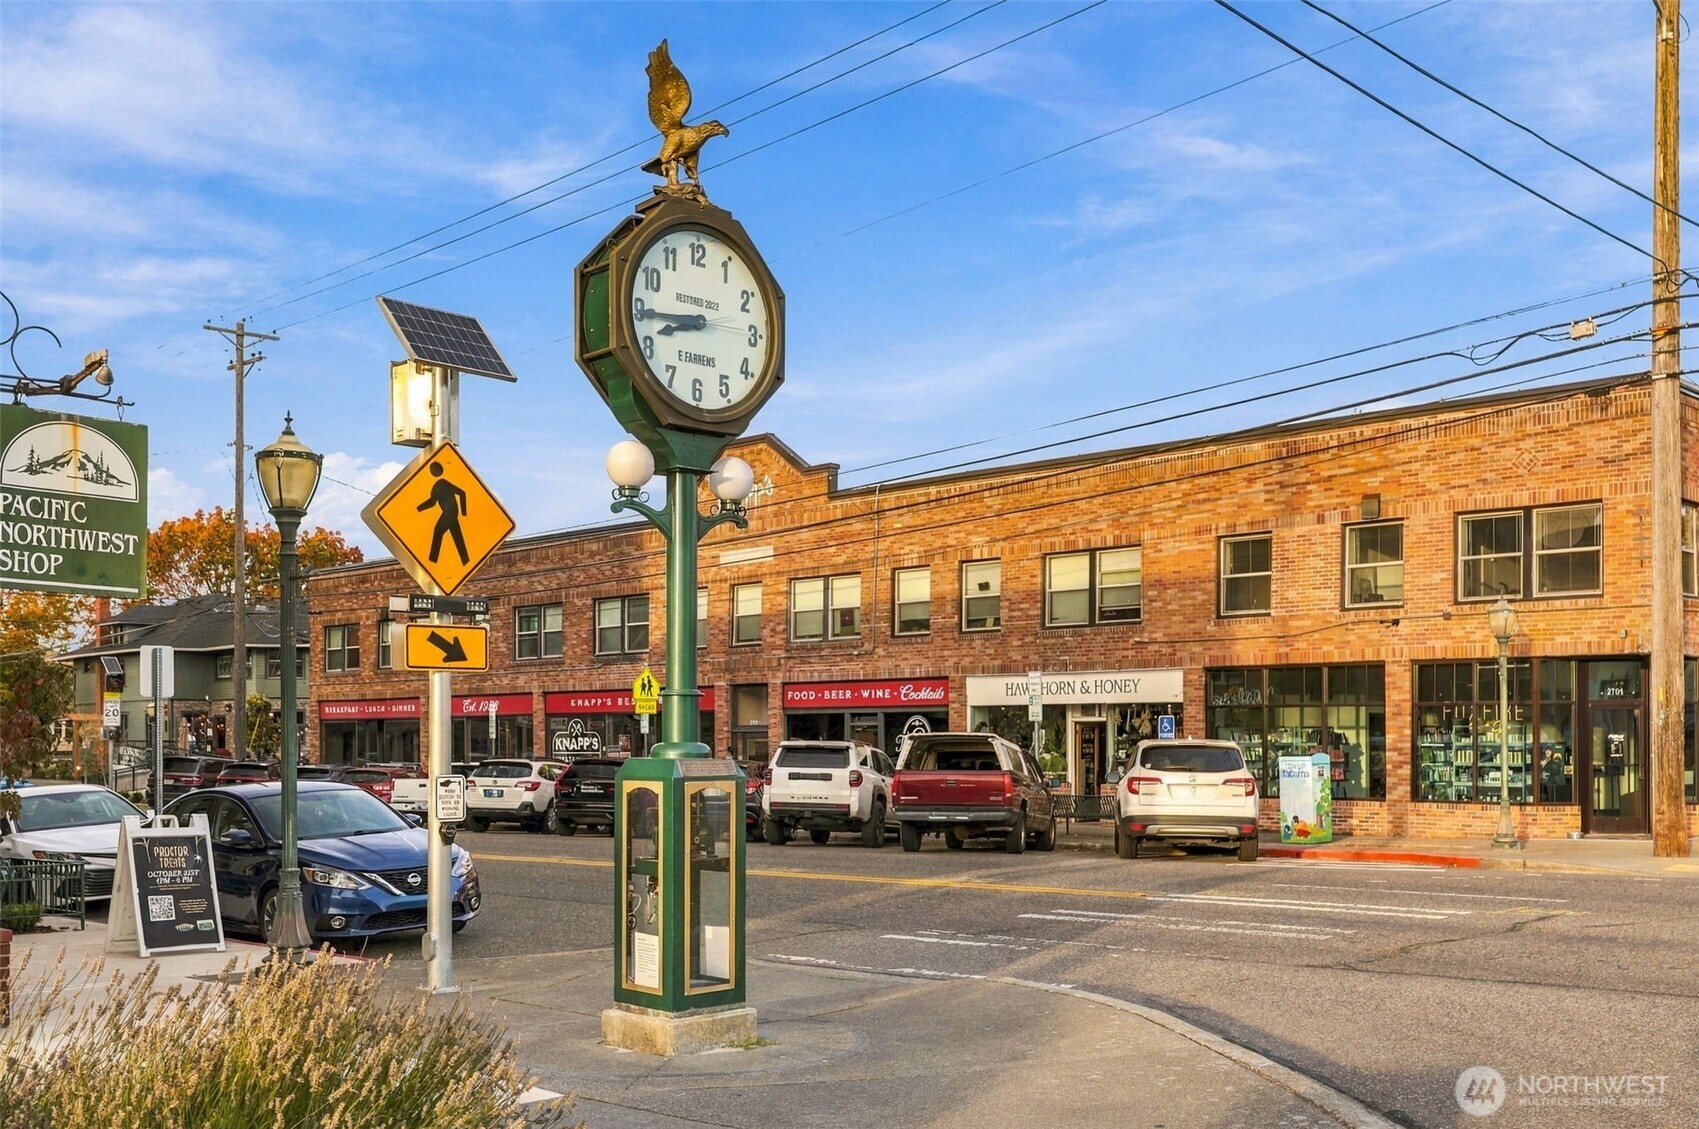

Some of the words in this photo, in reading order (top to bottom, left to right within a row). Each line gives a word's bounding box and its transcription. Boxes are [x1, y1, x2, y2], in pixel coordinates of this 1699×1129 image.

[663, 246, 677, 272] 11
[689, 242, 706, 268] 12
[642, 266, 661, 292] 10
[721, 260, 729, 283] 1
[634, 298, 645, 321] 9
[676, 292, 704, 308] RESTORED
[704, 300, 720, 311] 2022
[740, 289, 750, 313] 2
[643, 335, 654, 360] 8
[748, 324, 758, 348] 3
[678, 350, 684, 361] E
[685, 352, 716, 368] FARRENS
[740, 357, 750, 380] 4
[665, 364, 677, 388] 7
[719, 374, 730, 398] 5
[691, 378, 703, 402] 6
[0, 493, 88, 523] PACIFIC
[0, 521, 139, 556] NORTHWEST
[0, 549, 64, 575] SHOP
[787, 691, 816, 700] FOOD
[824, 689, 852, 699] BEER
[861, 689, 891, 699] WINE
[899, 684, 944, 701] Cocktails
[1005, 681, 1076, 697] HAWHORN
[1080, 680, 1091, 695] &
[1094, 678, 1141, 694] HONEY
[1606, 688, 1624, 696] 2701
[105, 709, 119, 717] 20
[365, 705, 386, 713] LUNCH
[392, 704, 416, 712] DINNER
[570, 698, 612, 707] KNAPP'S
[555, 737, 599, 751] KNAPP'S
[153, 846, 189, 857] PROCTOR
[159, 857, 186, 868] TREATS
[147, 870, 182, 878] OCTOBER
